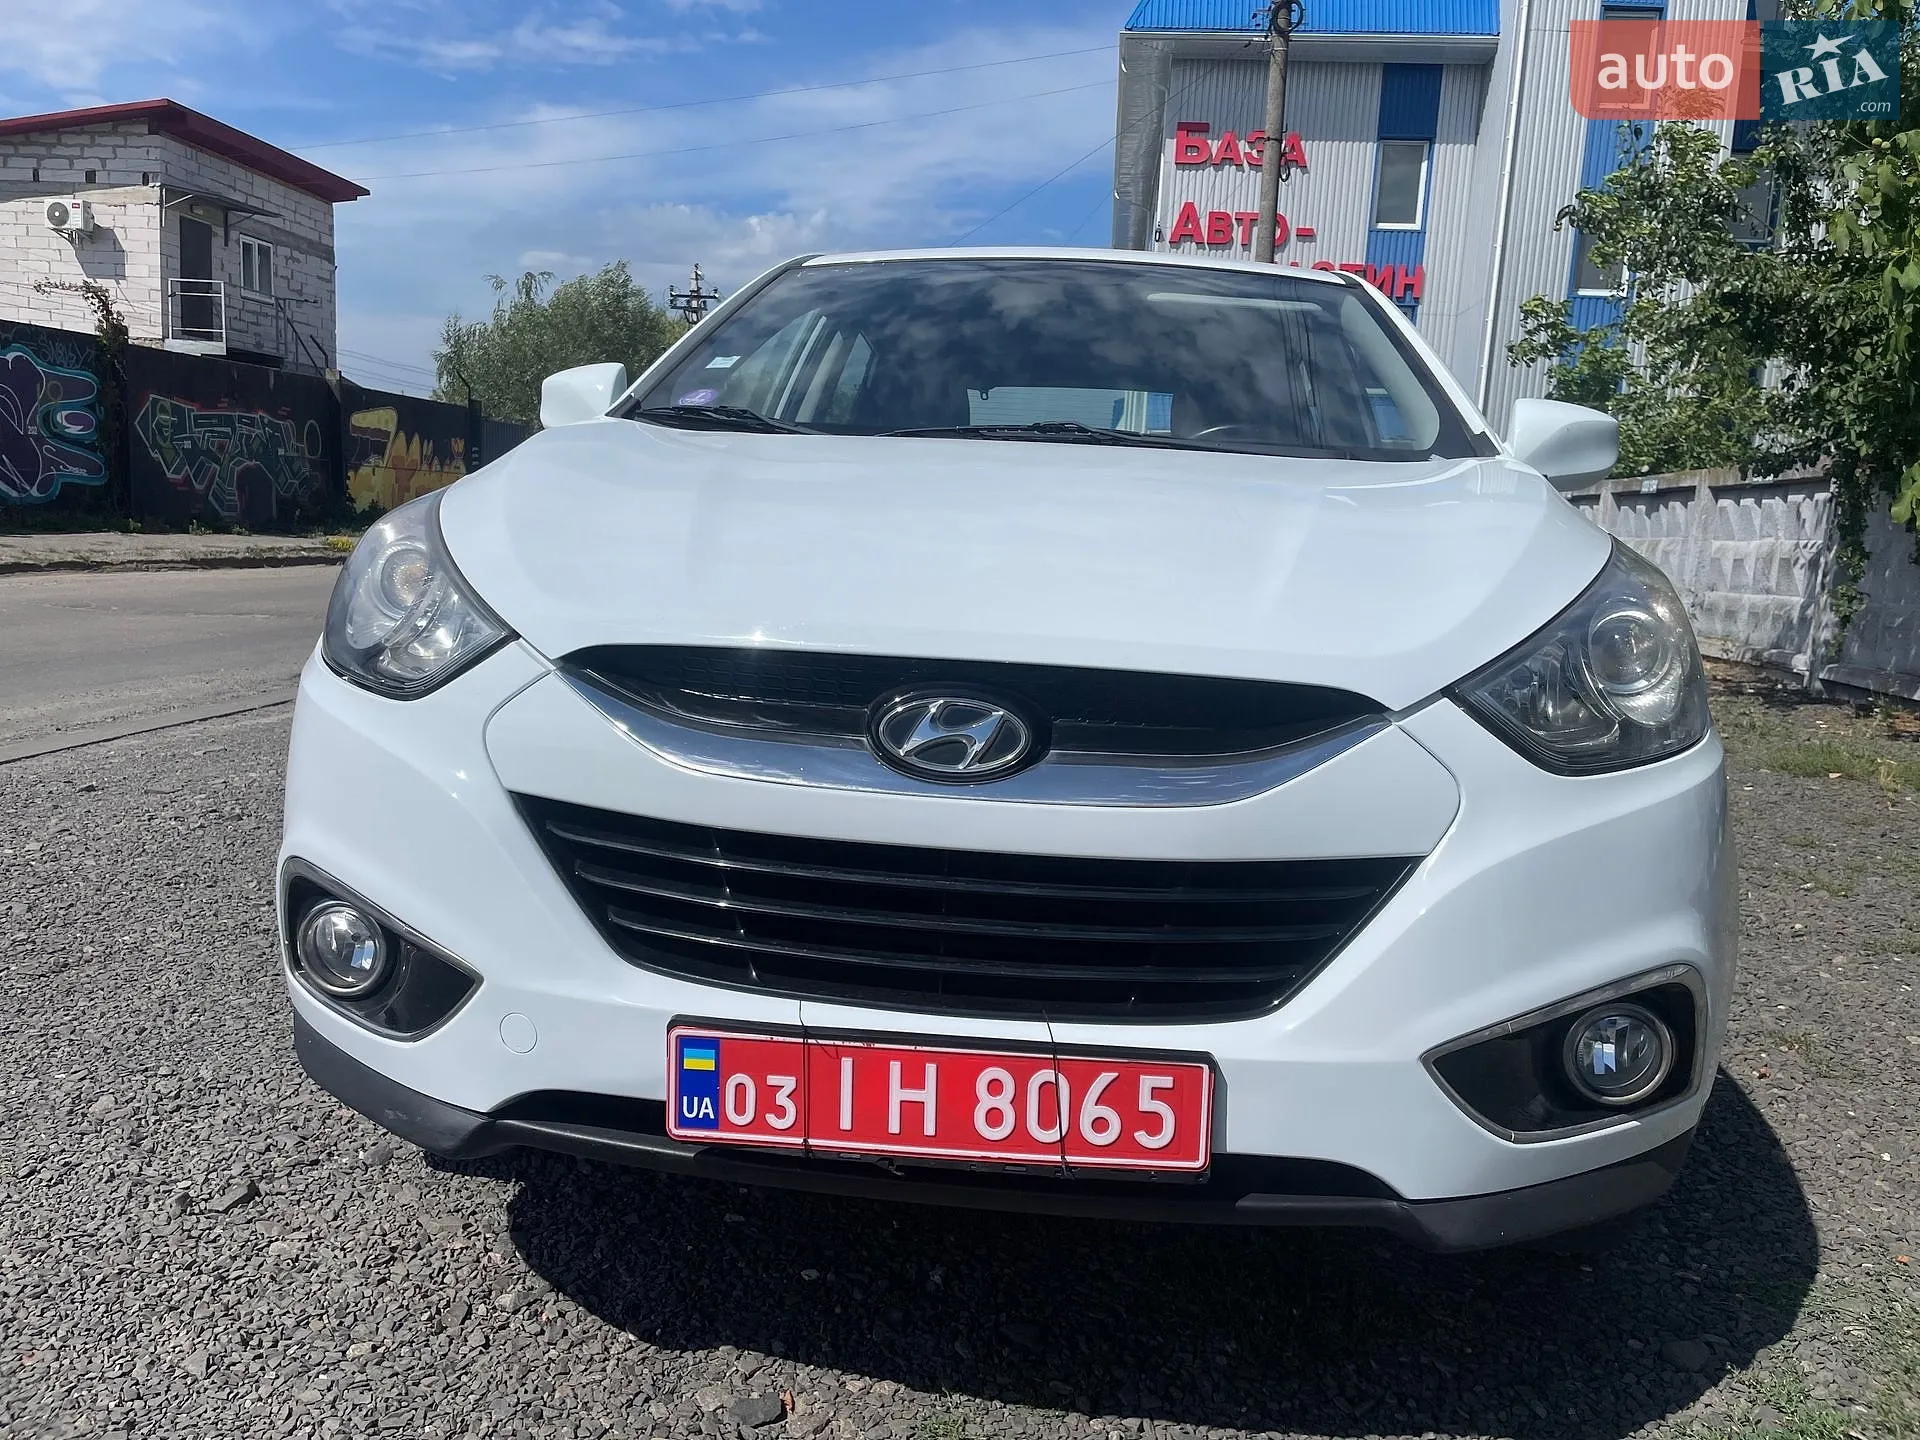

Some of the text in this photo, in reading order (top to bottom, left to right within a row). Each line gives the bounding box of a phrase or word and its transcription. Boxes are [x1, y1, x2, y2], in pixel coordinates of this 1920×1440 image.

[1174, 122, 1308, 168] БАЗА
[682, 1096, 715, 1120] UA
[725, 1073, 797, 1131] 03
[973, 1066, 1176, 1150] 8065
